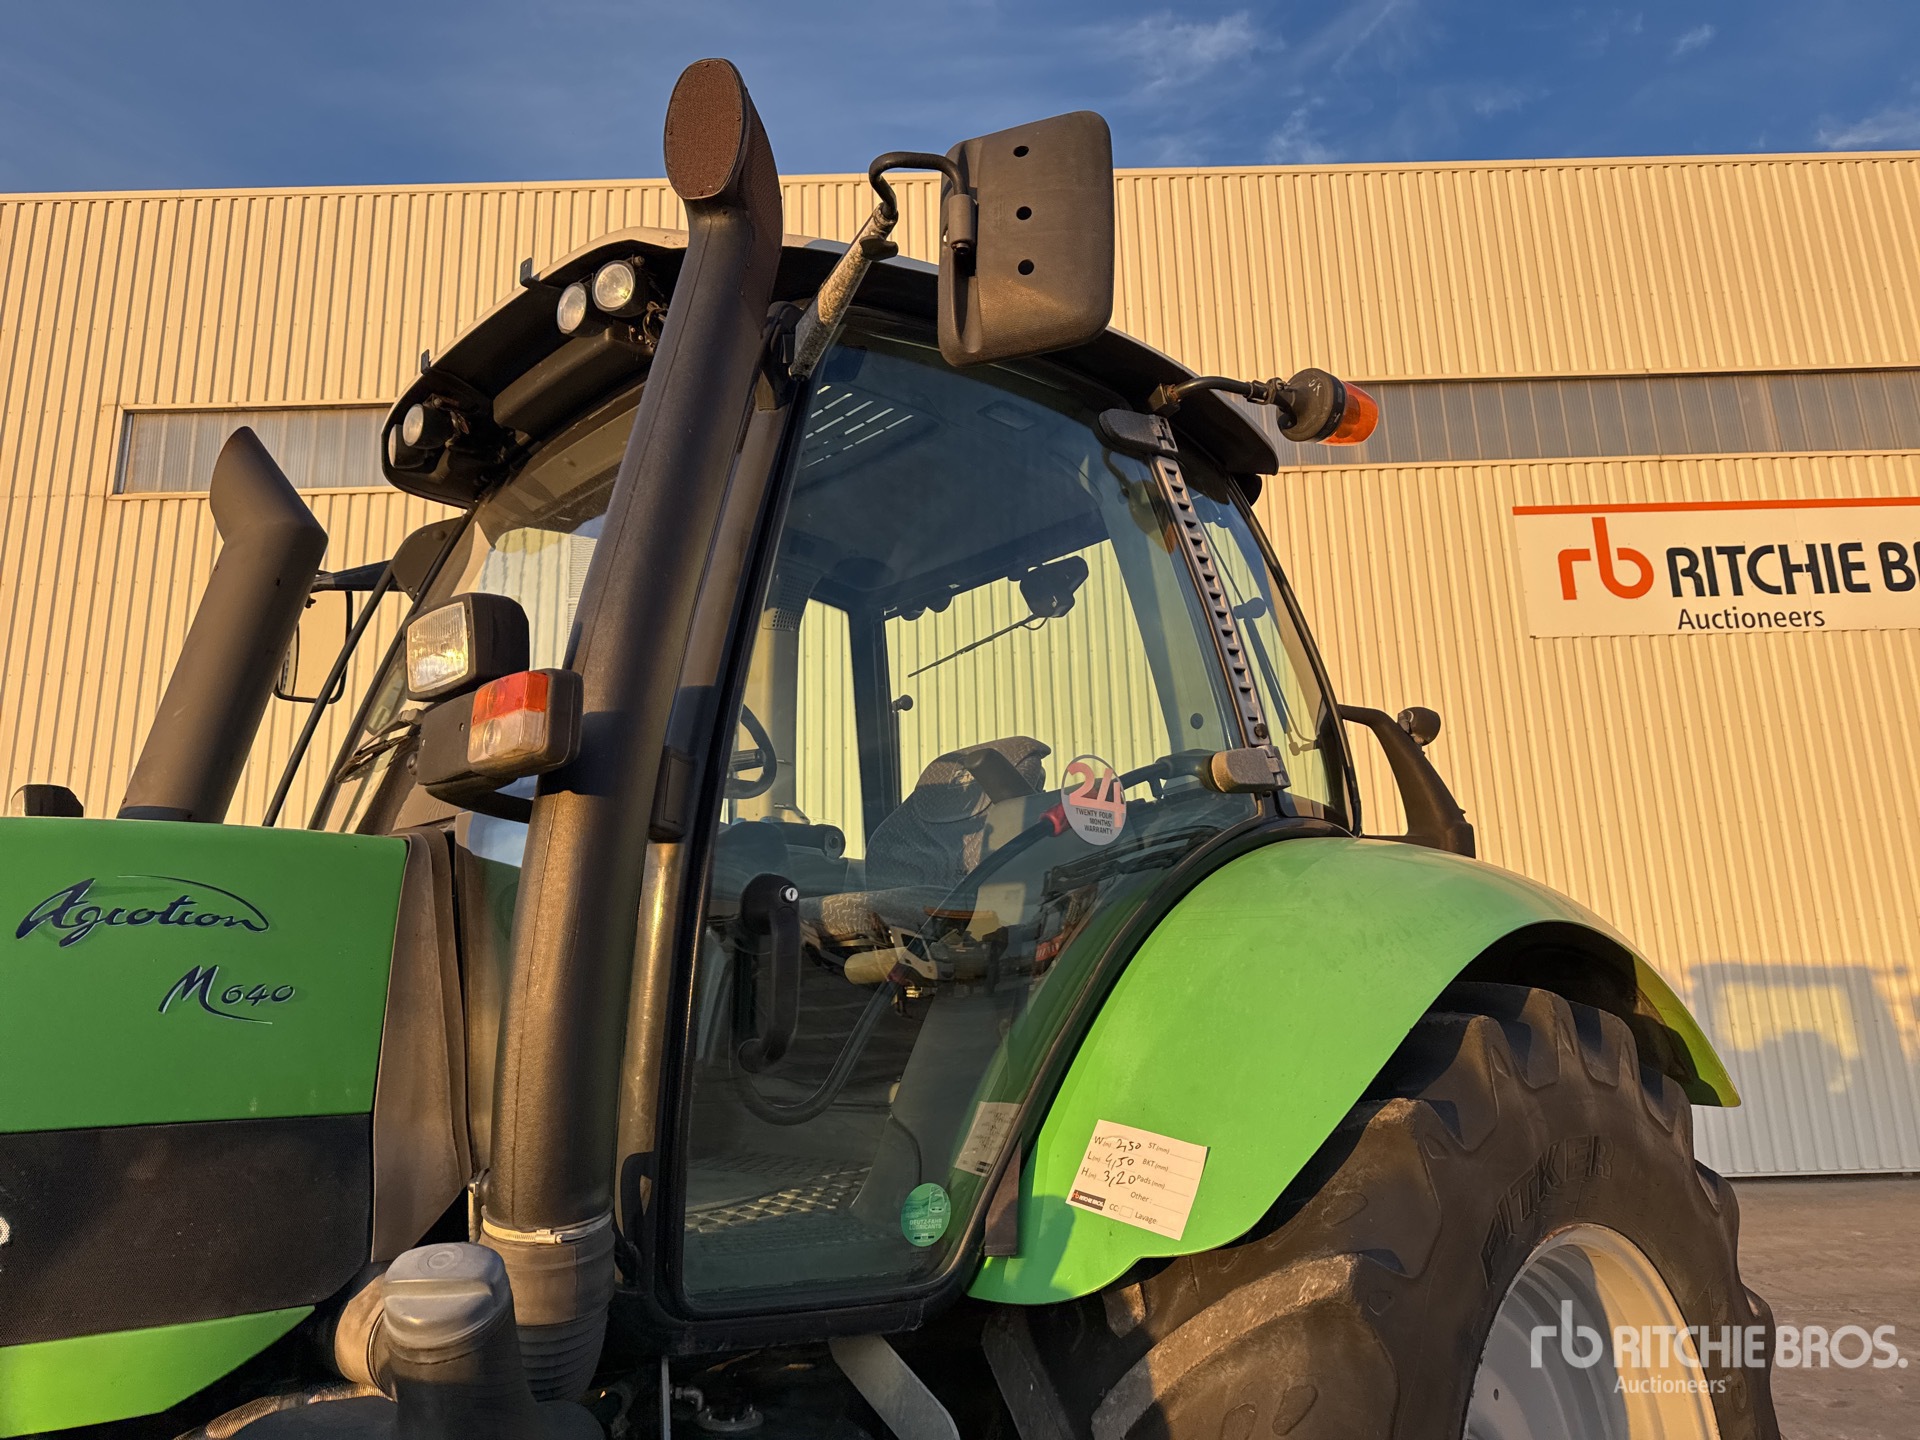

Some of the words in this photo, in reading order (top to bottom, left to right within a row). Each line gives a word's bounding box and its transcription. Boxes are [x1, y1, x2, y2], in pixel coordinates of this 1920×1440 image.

[1557, 517, 1654, 600] rb
[1666, 542, 1872, 598] RITCHIE
[1878, 540, 1920, 593] B
[1677, 607, 1825, 630] Auctioneers
[1068, 762, 1125, 829] 24
[1075, 807, 1097, 818] TWENTY
[1098, 811, 1113, 820] FOUR
[1084, 824, 1113, 835] WARRANTY
[15, 874, 270, 948] Agrotron
[1137, 1174, 1152, 1185] Pads
